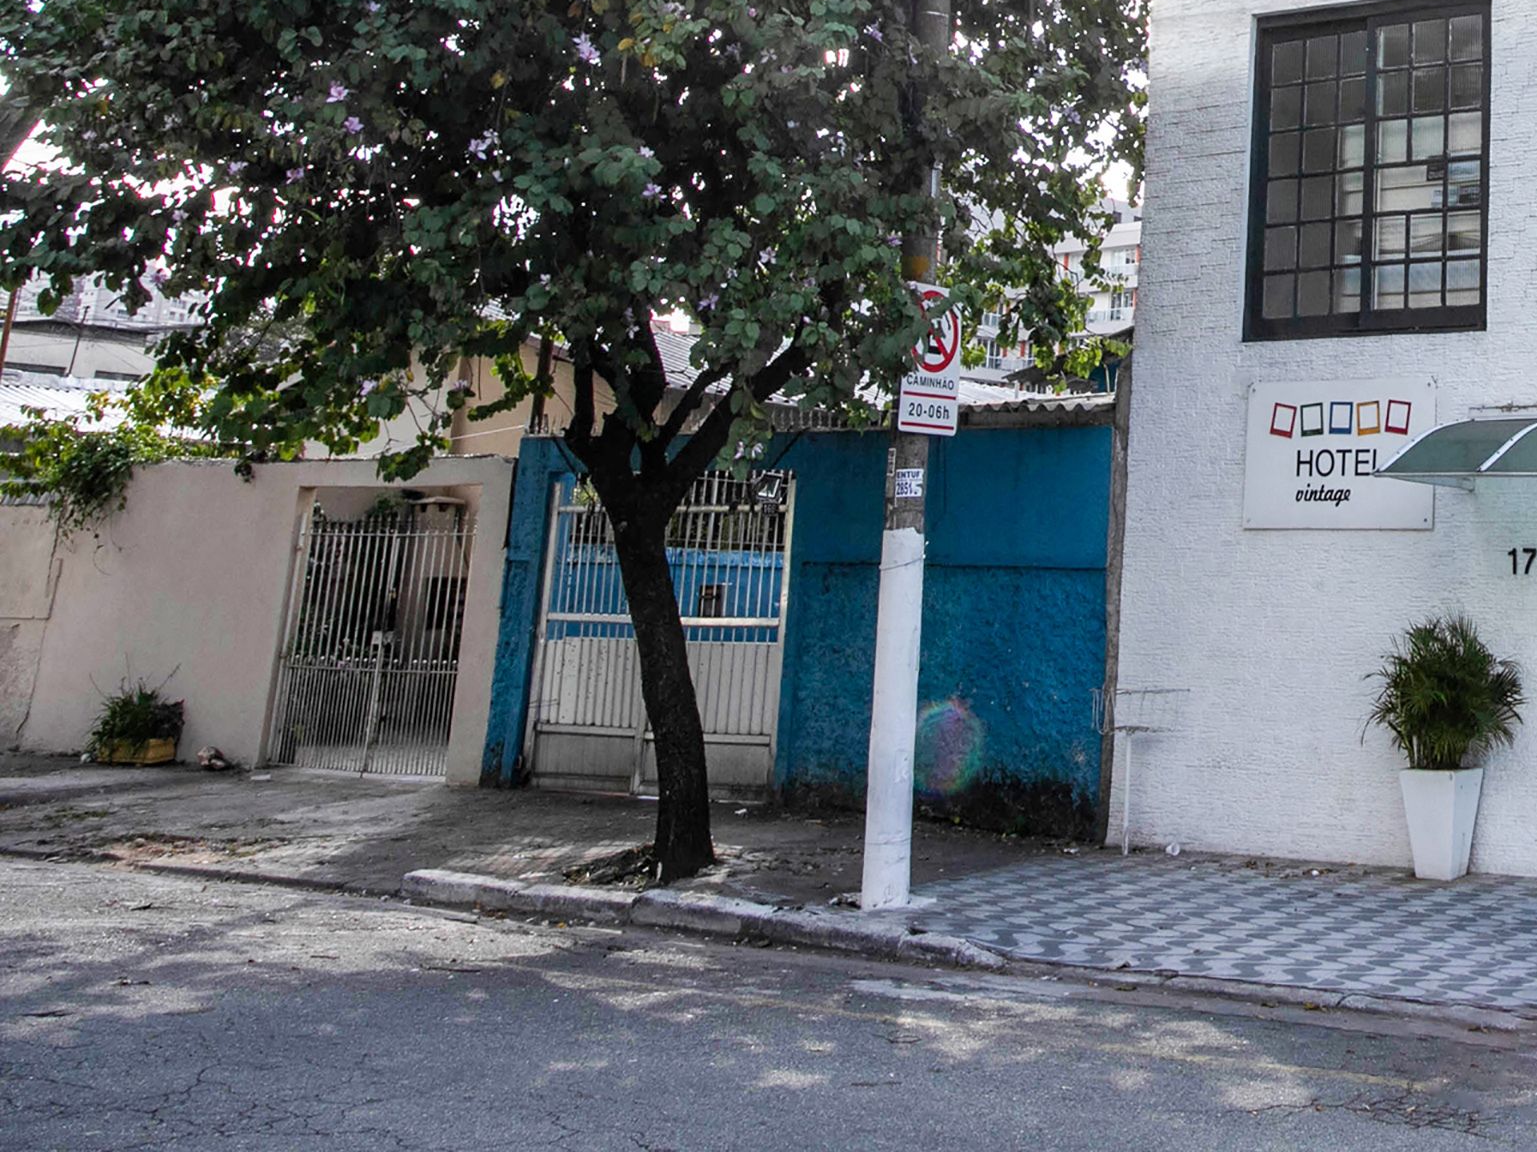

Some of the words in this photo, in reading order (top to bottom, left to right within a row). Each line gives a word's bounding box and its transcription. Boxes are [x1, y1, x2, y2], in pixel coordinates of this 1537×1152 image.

[906, 374, 955, 391] CAMINHÃO
[908, 402, 949, 420] 20-06h
[1295, 483, 1351, 508] vintage
